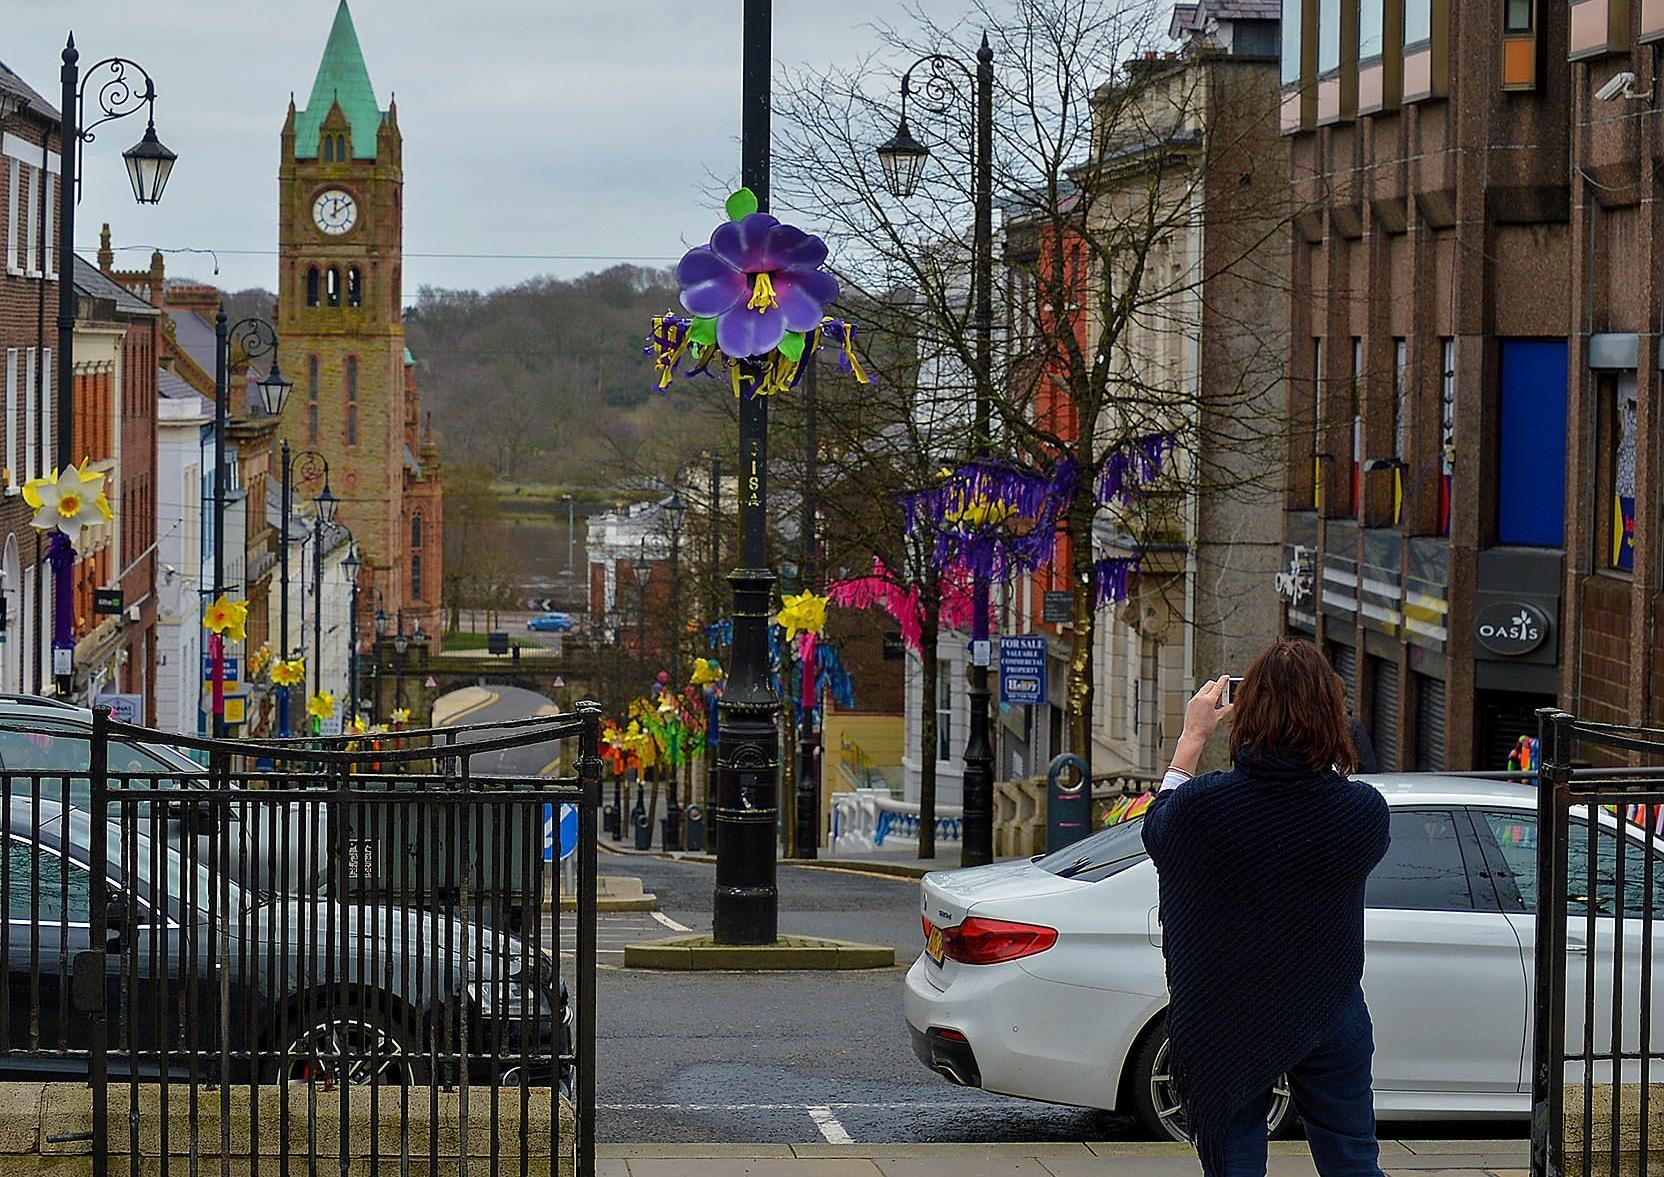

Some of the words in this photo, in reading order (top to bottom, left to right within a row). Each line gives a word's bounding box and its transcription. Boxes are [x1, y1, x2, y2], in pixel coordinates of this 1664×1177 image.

[1479, 616, 1539, 642] OASIS
[1000, 638, 1020, 649] FOR
[1021, 639, 1045, 649] SALE
[1000, 658, 1044, 666] COMMERCIAL
[1006, 666, 1039, 674] PROPERTY
